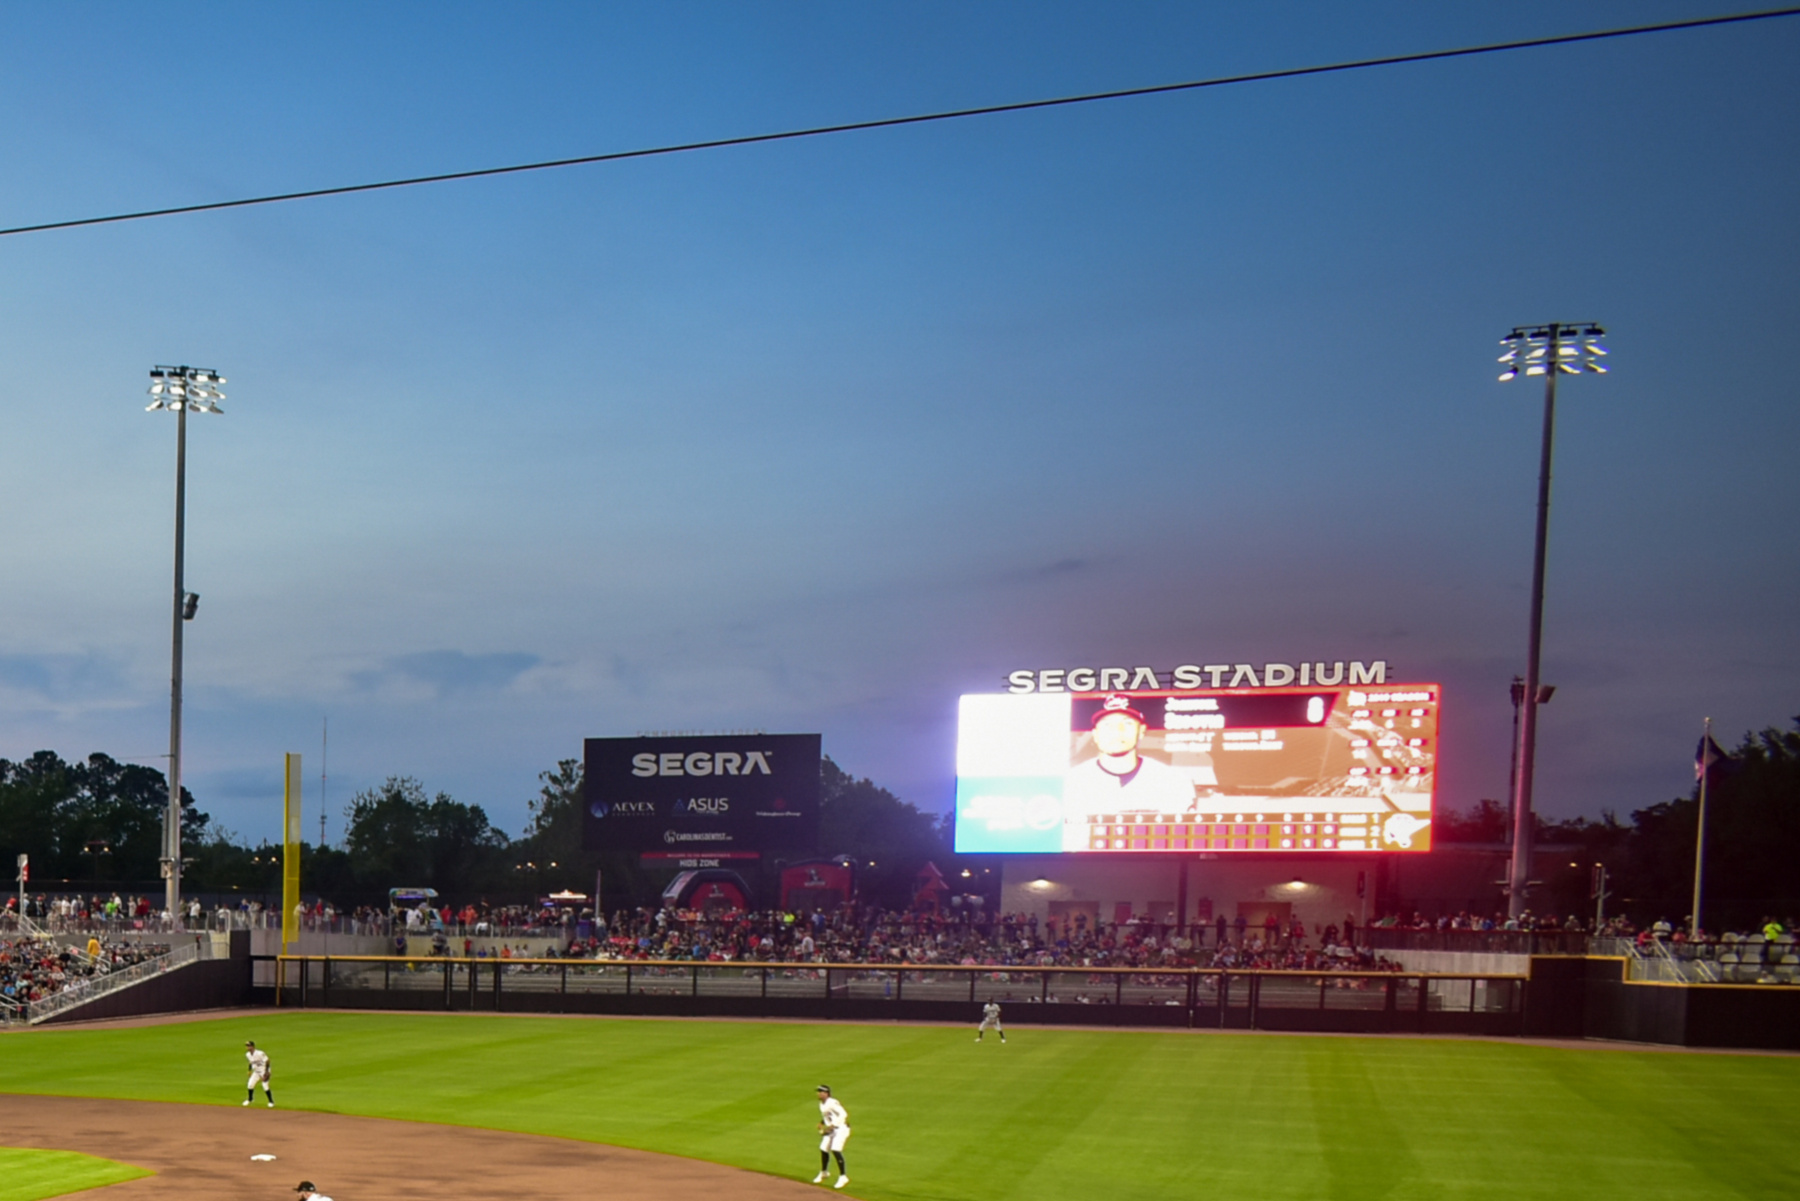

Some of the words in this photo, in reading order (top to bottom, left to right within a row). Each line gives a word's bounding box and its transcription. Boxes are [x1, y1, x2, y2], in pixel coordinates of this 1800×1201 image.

[1008, 667, 1160, 693] SEGRA
[1174, 661, 1386, 689] STADIUM
[631, 752, 772, 777] SEGRA
[687, 798, 729, 811] ASUS
